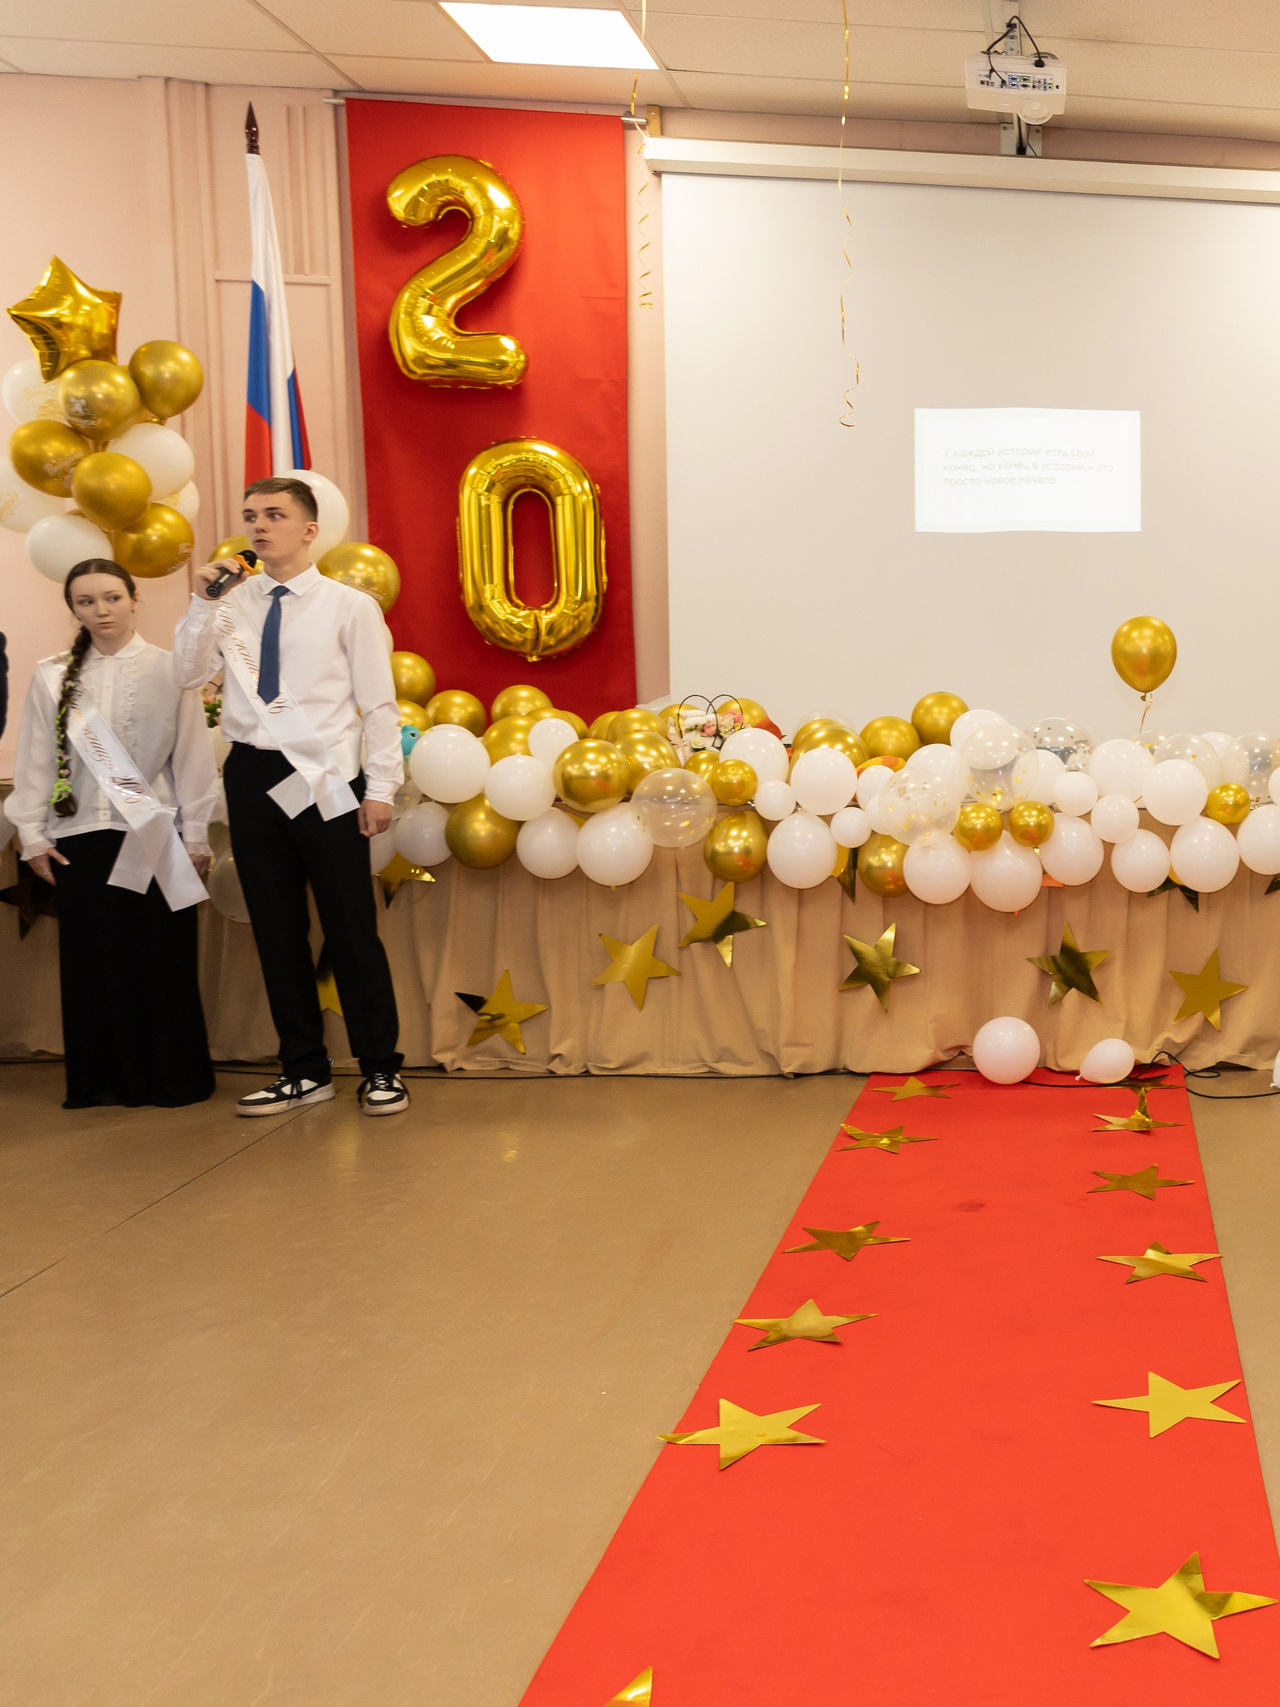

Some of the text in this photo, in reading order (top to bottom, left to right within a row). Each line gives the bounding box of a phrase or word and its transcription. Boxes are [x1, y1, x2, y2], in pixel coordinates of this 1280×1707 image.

[387, 154, 529, 389] 2
[943, 447, 1095, 458] У каждой истории есть свой
[943, 462, 978, 473] конец,
[982, 463, 995, 471] но
[998, 461, 1029, 471] конец
[1032, 462, 1039, 470] в
[1042, 463, 1085, 473] истории
[1096, 464, 1115, 472] это
[943, 476, 1057, 487] просто новое начало
[457, 436, 607, 662] 0
